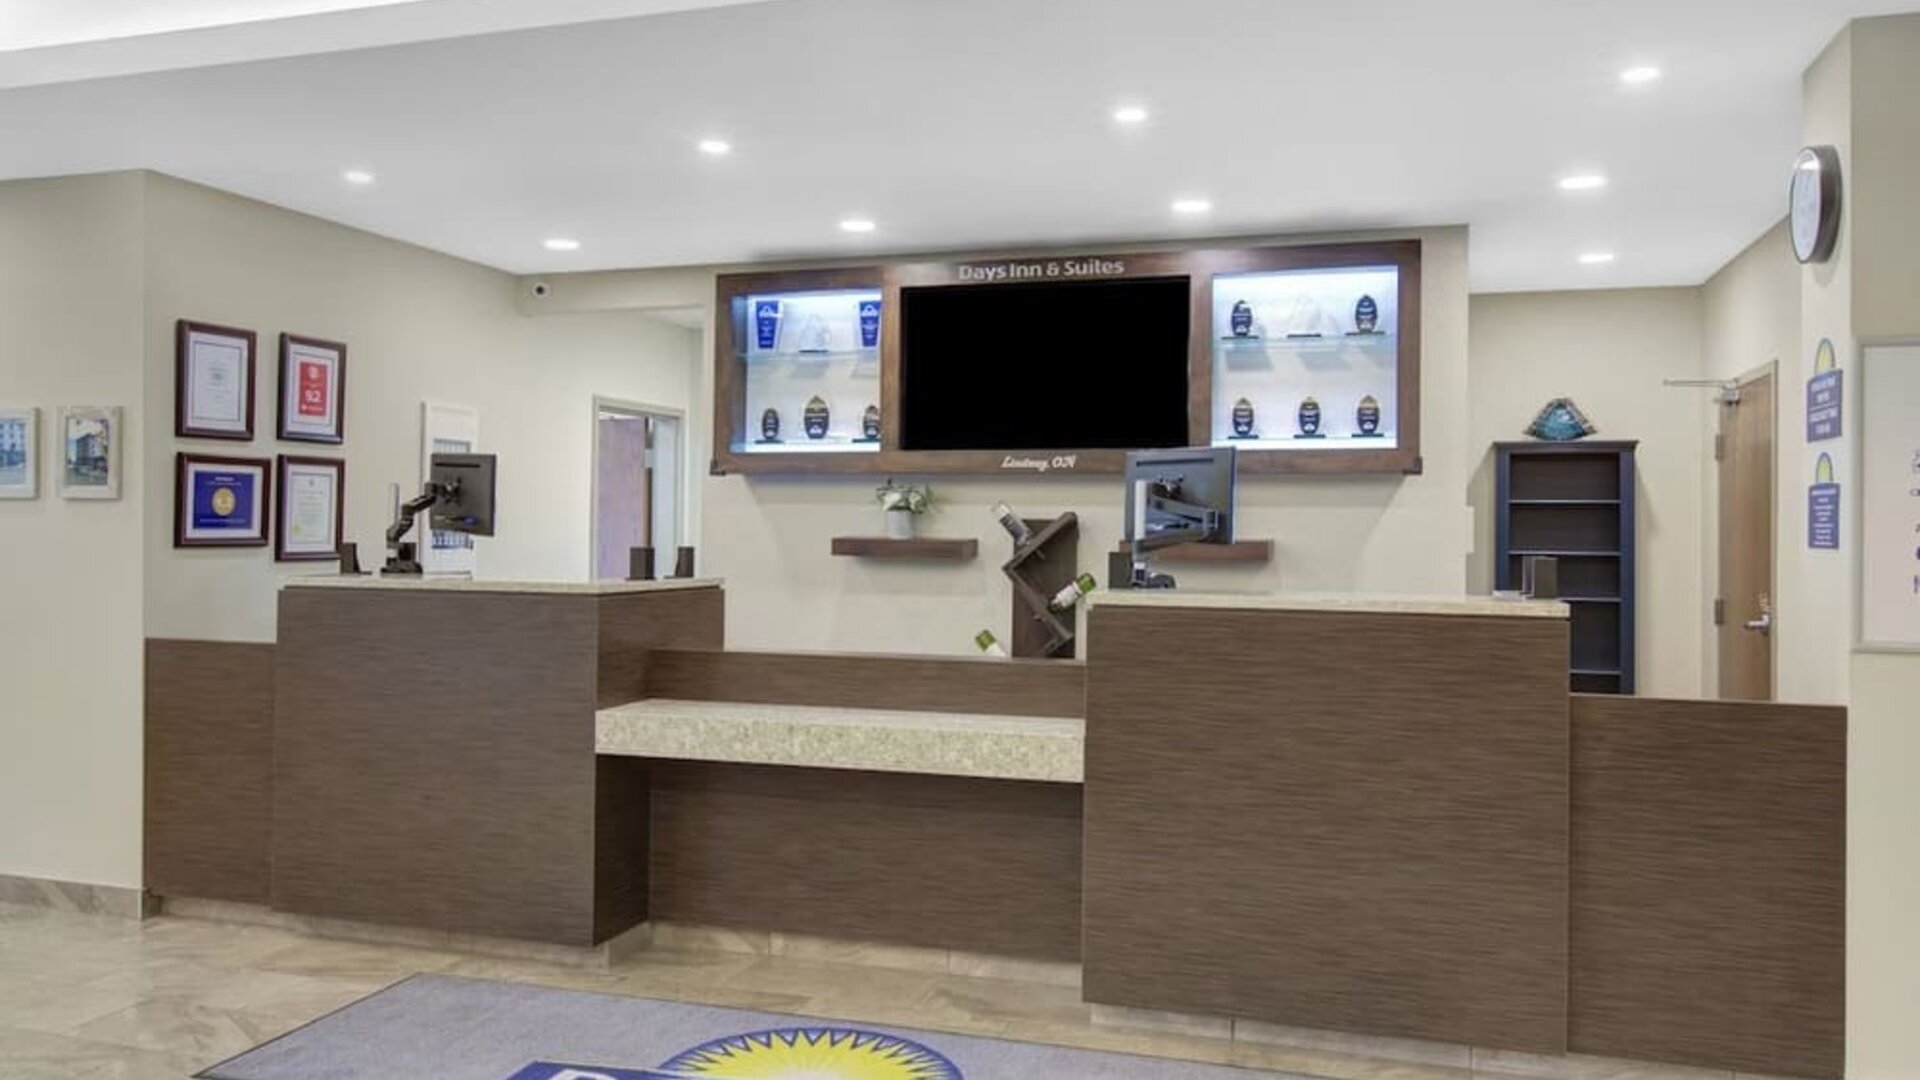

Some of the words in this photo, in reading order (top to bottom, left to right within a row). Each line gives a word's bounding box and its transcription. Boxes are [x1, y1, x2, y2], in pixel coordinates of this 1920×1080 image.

[959, 265, 1008, 281] Days
[1010, 262, 1042, 278] Inn
[1046, 261, 1060, 276] &
[1064, 259, 1124, 275] Suites
